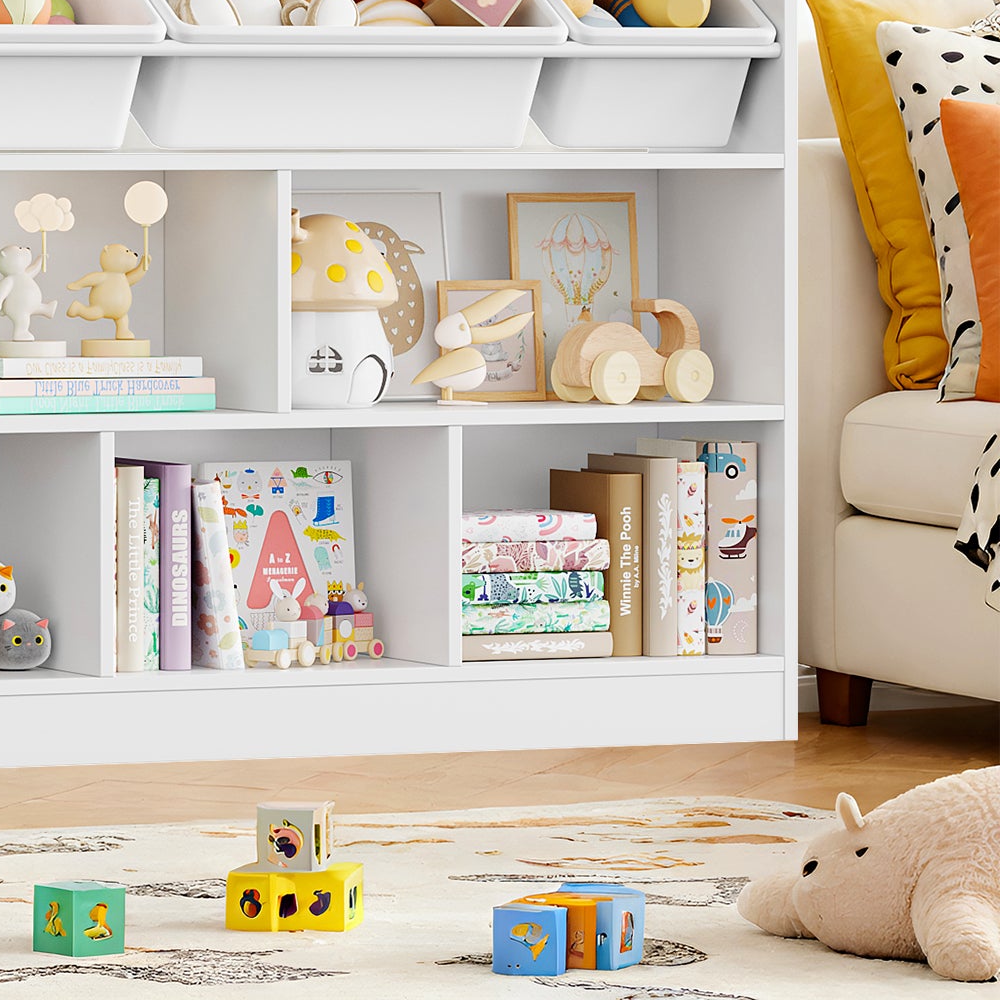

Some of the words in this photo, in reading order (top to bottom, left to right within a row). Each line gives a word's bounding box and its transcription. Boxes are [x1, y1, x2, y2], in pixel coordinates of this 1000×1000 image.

[128, 496, 141, 529] The
[619, 506, 632, 541] Pooh
[128, 534, 141, 582] Little
[171, 508, 188, 627] DINOSAURS
[269, 553, 276, 564] A
[285, 552, 291, 563] Z
[619, 543, 632, 569] The
[619, 571, 632, 617] Winnie
[128, 586, 141, 643] Prince
